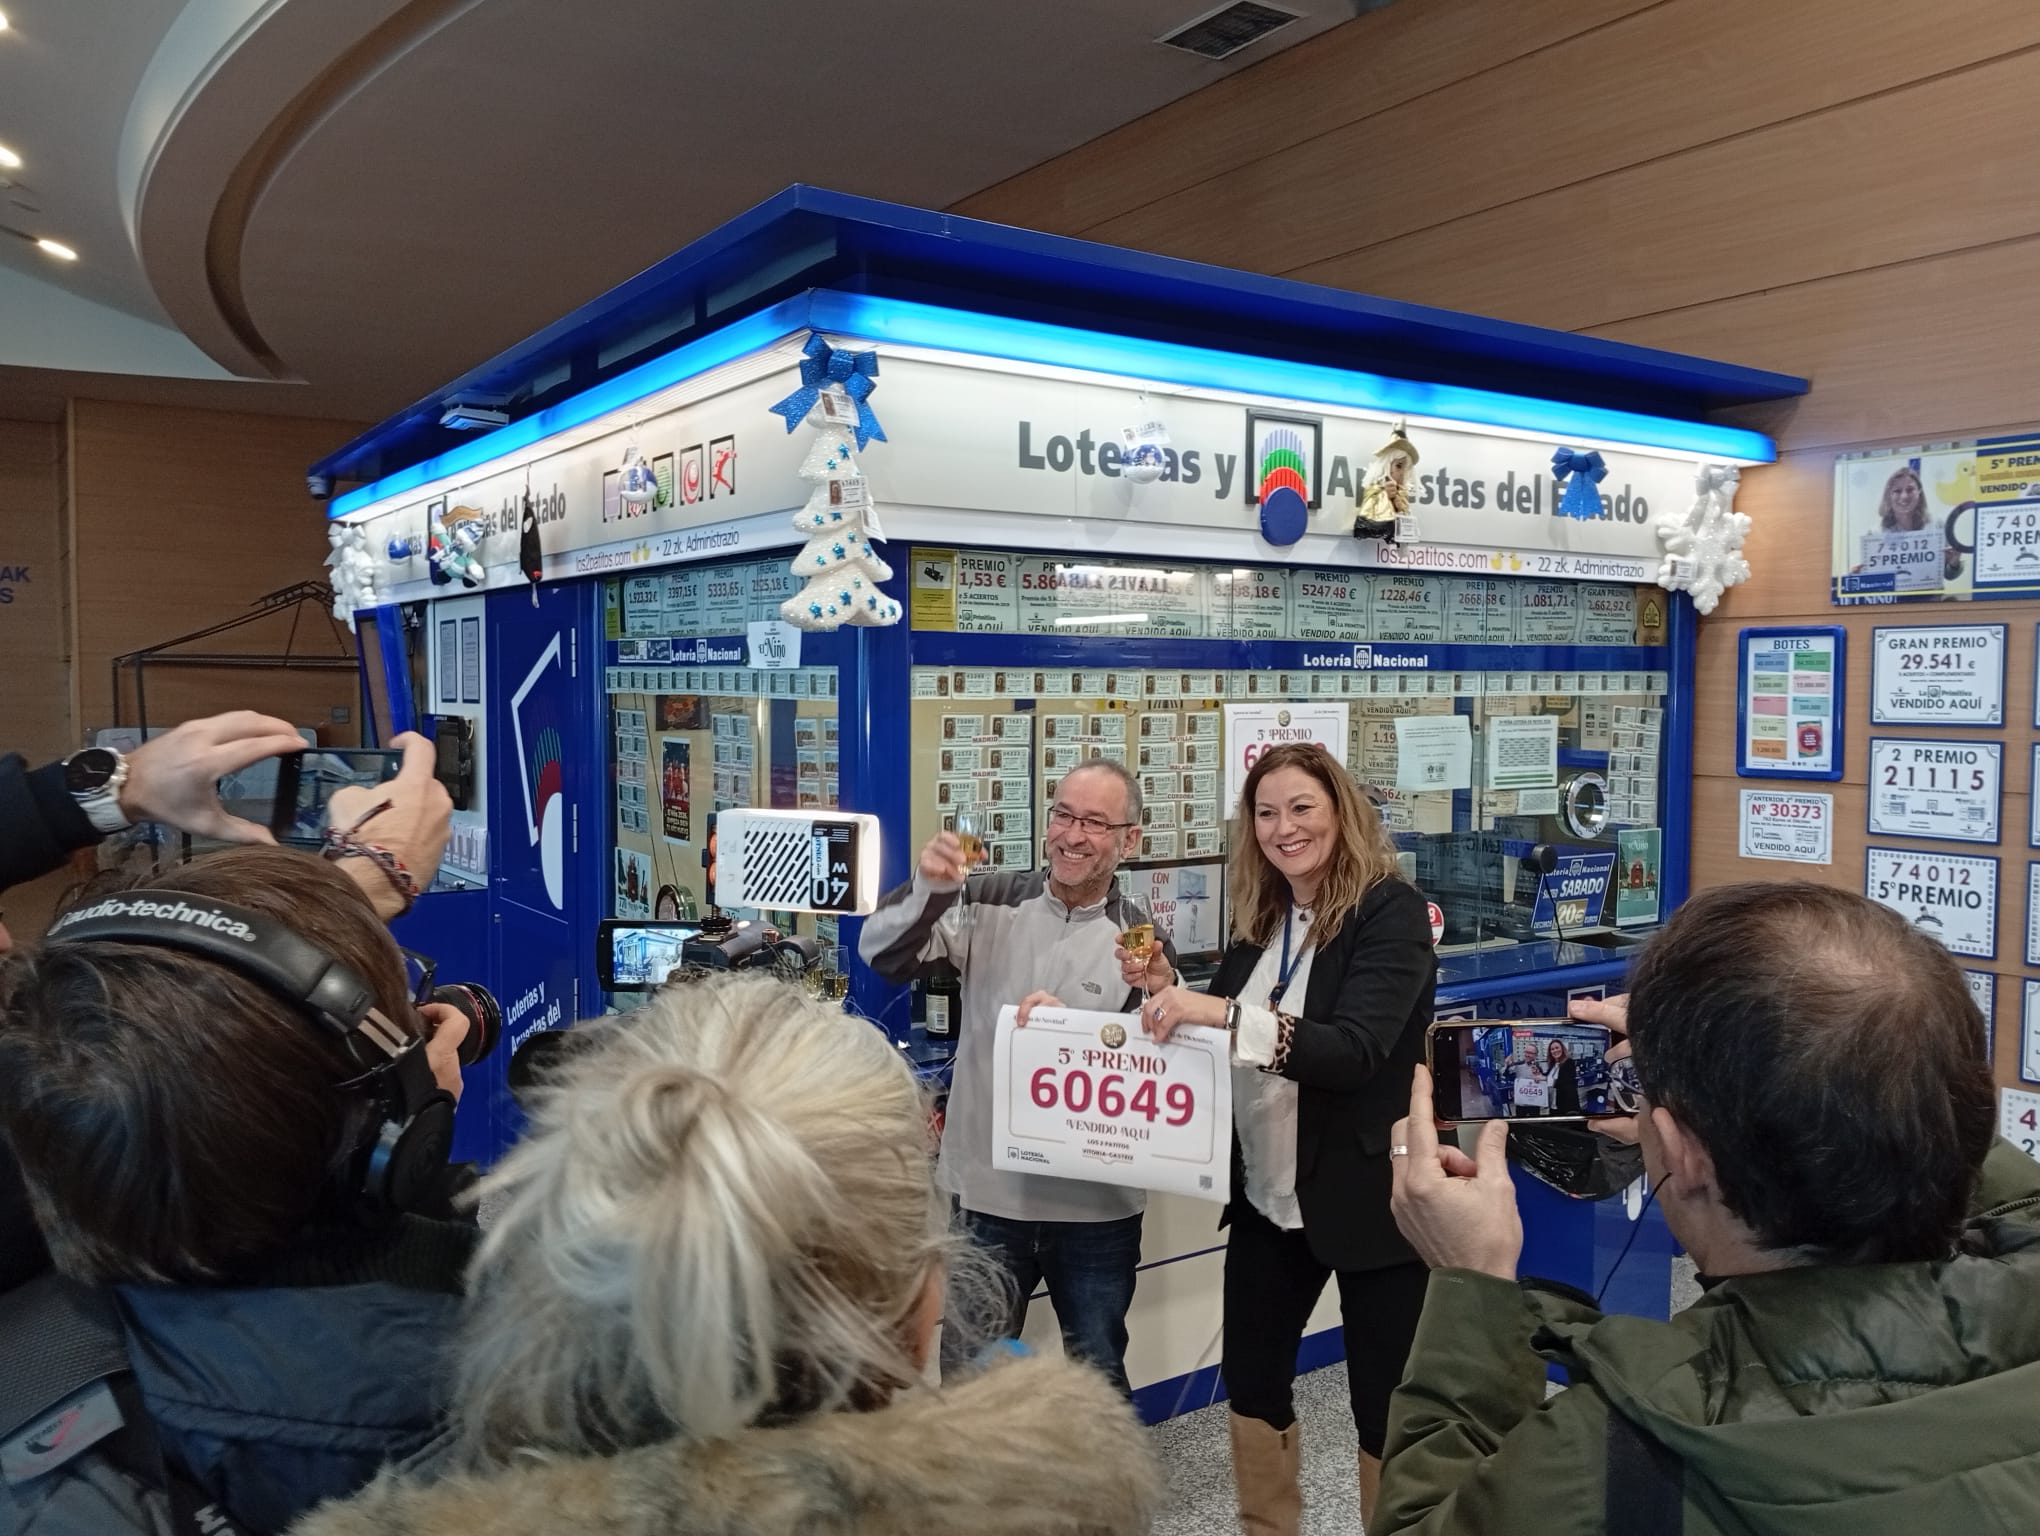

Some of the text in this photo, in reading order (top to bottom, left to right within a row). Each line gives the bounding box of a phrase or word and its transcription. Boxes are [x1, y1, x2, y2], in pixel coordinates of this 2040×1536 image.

[1019, 420, 1201, 484] Loteas
[1214, 453, 1236, 499] y
[1326, 454, 1485, 510] Astas
[1497, 470, 1541, 515] del
[1980, 482, 2027, 493] VENDIDO
[501, 493, 517, 532] del
[576, 550, 631, 572] los2patitos.com
[663, 538, 671, 556] 22
[686, 525, 739, 550] Administrazio
[961, 558, 1005, 571] PREMIO
[1882, 551, 1935, 565] PREMIO
[713, 568, 733, 577] PREMIO
[1538, 556, 1550, 572] 22
[1554, 556, 1569, 573] zk.
[1574, 559, 1644, 578] Administrazio
[634, 579, 650, 588] PREMIO
[671, 573, 689, 582] PREMIO
[782, 576, 789, 590] €
[996, 575, 1006, 587] €
[1314, 571, 1349, 583] PREMIO
[1393, 576, 1424, 587] PREMIO
[667, 584, 697, 599] 3397,15 €
[708, 581, 744, 598] 5333,65 €
[1272, 586, 1280, 598] €
[1348, 588, 1356, 599] €
[1380, 588, 1430, 602] 1228,46 €
[1537, 585, 1563, 593] PREMIO
[1587, 588, 1607, 596] GRAN
[653, 590, 658, 602] €
[1498, 594, 1505, 605] €
[1524, 594, 1575, 608] 1.081,71 €
[1588, 599, 1631, 610] 2.662,92 €
[1256, 628, 1276, 637] AQUÍ
[1300, 628, 1359, 639] VENDIDO AQUÍ
[1379, 631, 1433, 640] VENDIDO AQUÍ
[1526, 633, 1567, 641] VENDIDO AQUÍ
[1585, 633, 1612, 642] VENDIDO
[764, 636, 785, 657] Niño
[1773, 639, 1810, 649] BOTES
[1888, 636, 1987, 649] GRAN PREMIO
[707, 646, 741, 661] Nacional
[1303, 652, 1428, 667] Lotería Nacional
[1900, 653, 1975, 669] 29.541 €
[1890, 696, 1981, 709] VENDIDO AQUÍ
[1269, 727, 1311, 740] PREMIO
[1914, 748, 1977, 764] PREMIO
[1368, 760, 1395, 768] VENDIDO
[1368, 778, 1384, 786] GRAN
[1769, 803, 1821, 819] 30373
[1753, 841, 1815, 853] VENDIDO AQUÍ
[832, 861, 848, 874] W
[1582, 863, 1609, 873] Nacional
[1151, 871, 1169, 884] CON
[812, 876, 849, 905] 40
[1560, 877, 1604, 898] SABADO
[1899, 882, 1981, 909] PREMIO
[1152, 900, 1176, 913] JUEGO
[1166, 913, 1175, 926] SE
[538, 981, 544, 1004] y
[547, 997, 561, 1026] del
[1082, 1049, 1167, 1076] PREMIO
[1030, 1066, 1195, 1126] 60649
[1519, 1087, 1542, 1096] 60649
[1066, 1118, 1150, 1140] VENDIDO AQUÍ
[1104, 1141, 1129, 1149] PATITOS
[1020, 1156, 1050, 1164] NACIONAL
[1081, 1148, 1134, 1160] VITORIA-GASTEIZ
